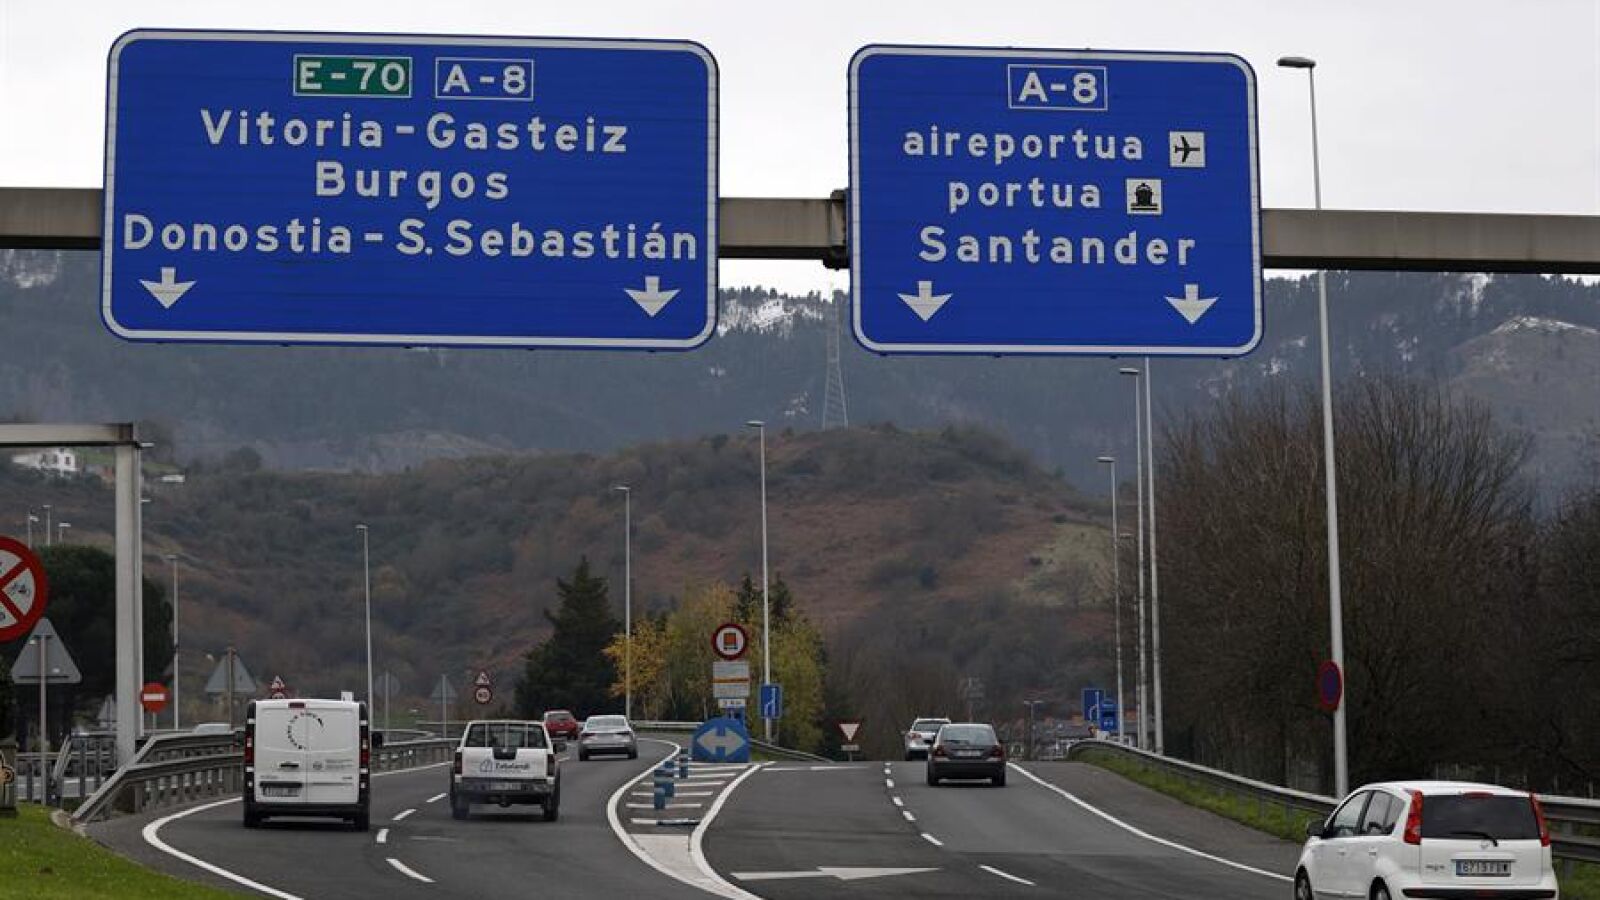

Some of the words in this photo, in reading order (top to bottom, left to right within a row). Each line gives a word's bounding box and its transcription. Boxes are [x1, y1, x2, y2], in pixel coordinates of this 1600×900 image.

[300, 61, 405, 92] E-70
[442, 64, 526, 95] A-8
[1018, 72, 1098, 104] A-8
[904, 125, 1142, 165] aireportua
[316, 161, 508, 209] Burgos
[949, 177, 1100, 214] portua
[919, 225, 1195, 266] Santander
